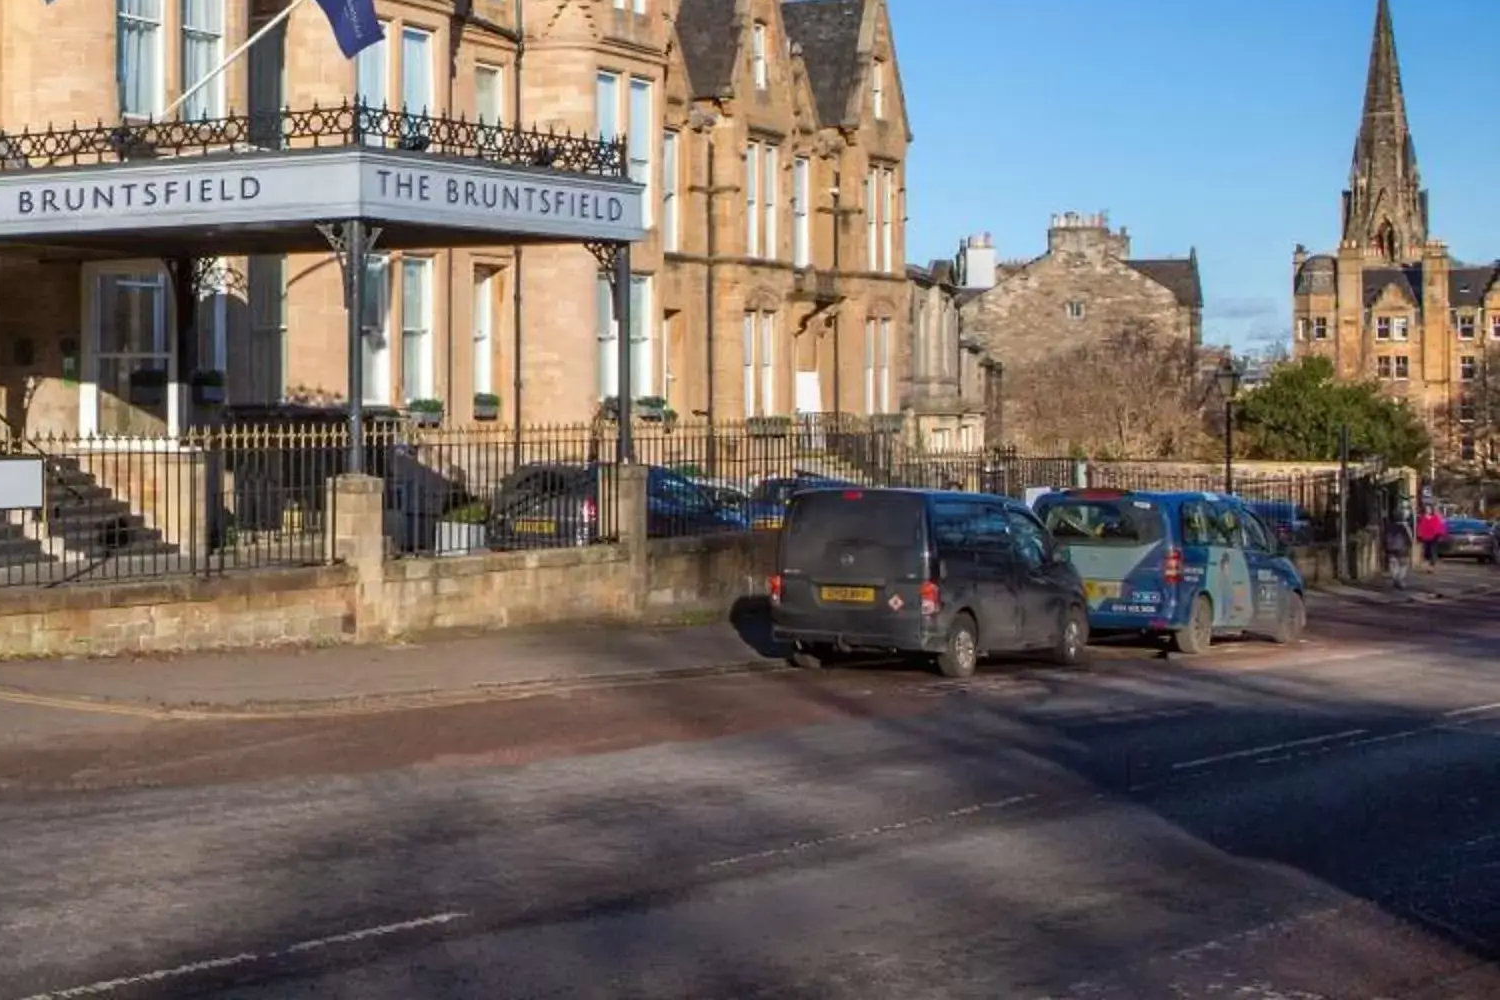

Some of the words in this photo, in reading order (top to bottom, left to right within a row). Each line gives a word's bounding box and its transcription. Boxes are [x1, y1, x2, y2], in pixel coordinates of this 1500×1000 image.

[18, 177, 261, 213] BRUNTSFIELD
[377, 170, 429, 201] THE
[446, 179, 622, 221] BRUNTSFIELD
